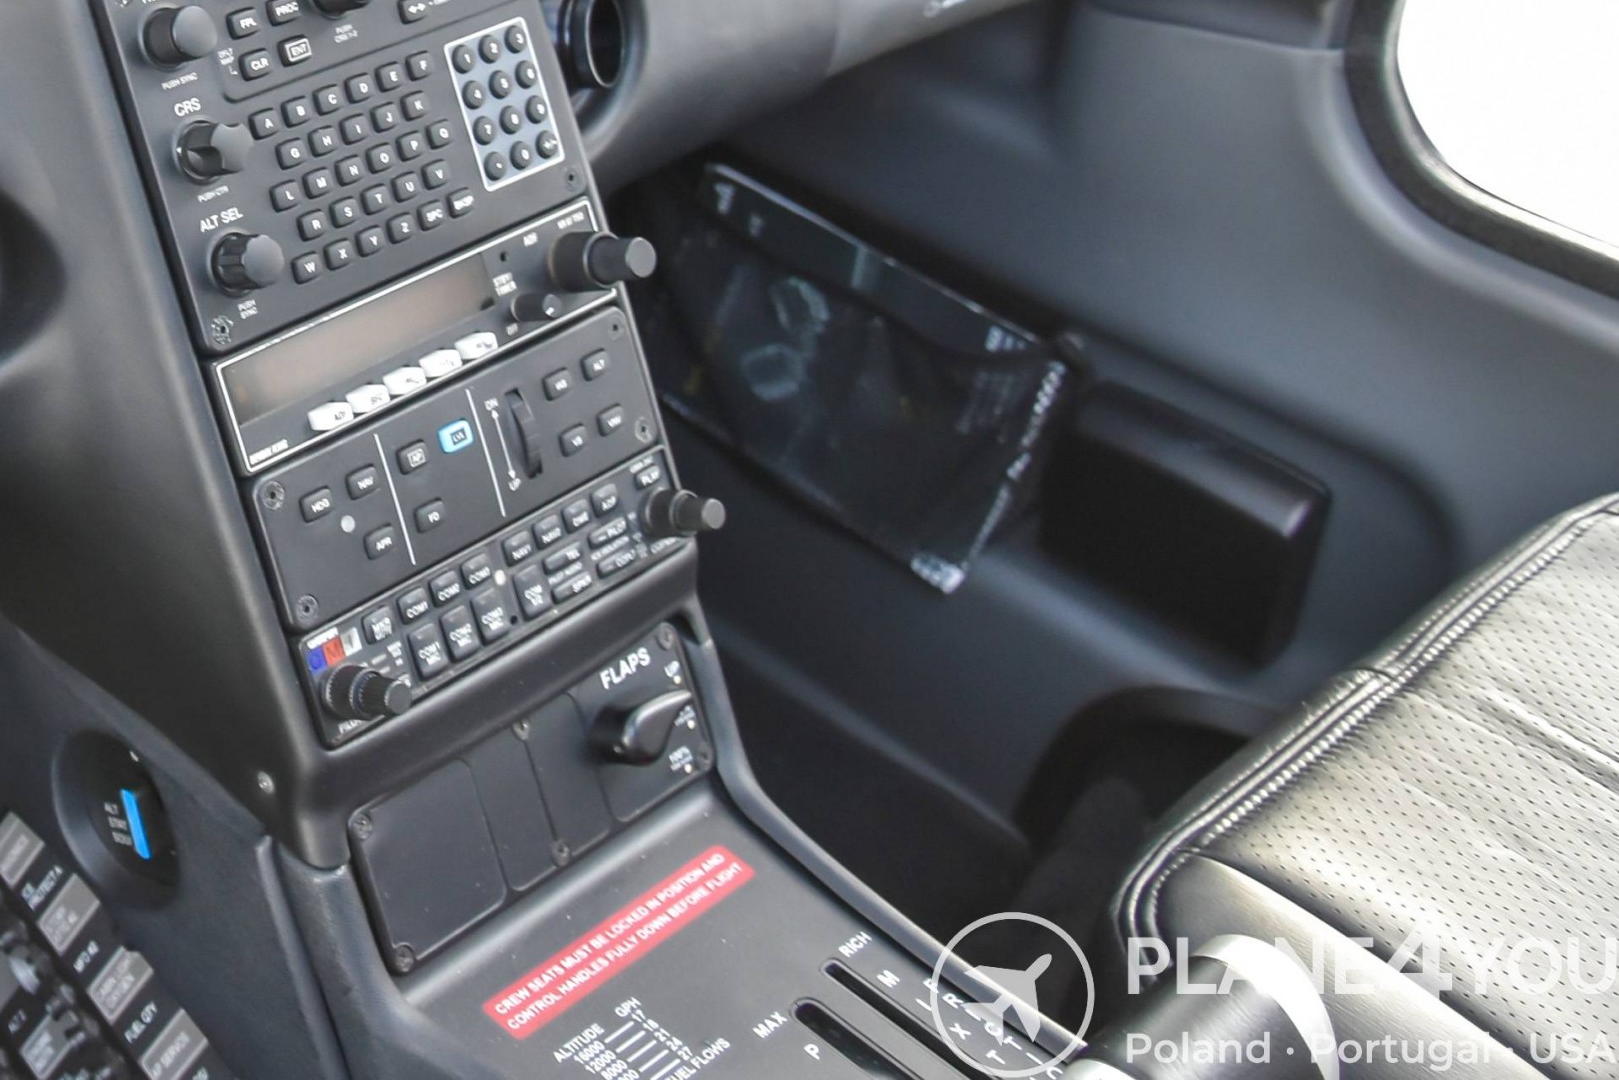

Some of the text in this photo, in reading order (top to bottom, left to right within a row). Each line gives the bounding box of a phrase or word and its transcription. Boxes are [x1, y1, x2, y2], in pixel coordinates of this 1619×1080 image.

[275, 1, 300, 16] PROC
[240, 16, 258, 29] FPL
[292, 44, 308, 56] ENT
[250, 57, 270, 70] CLR
[174, 98, 202, 117] CRS
[410, 140, 419, 152] P
[348, 164, 359, 176] N
[434, 168, 444, 180] V
[404, 181, 415, 192] U
[200, 206, 244, 233] ALT SEL
[344, 206, 352, 218] S
[312, 219, 322, 231] R
[370, 235, 378, 246] Y
[338, 248, 348, 260] X
[304, 262, 316, 274] W
[357, 476, 374, 490] NAV
[310, 498, 330, 514] HDG
[376, 536, 392, 552] APR
[512, 544, 532, 560] NAV1
[524, 584, 543, 600] COM
[406, 601, 429, 618] COM1
[600, 647, 651, 690] FLAPS
[494, 853, 725, 1016] CREW SEATS MUST BE LOCKED IN POSITION AND
[506, 862, 744, 1030] CONTROL HANDLES FULLY DOWN BEFORE FLIGHT
[838, 930, 872, 958] RICH
[614, 996, 642, 1018] GPH
[631, 1009, 646, 1022] 17
[752, 1011, 788, 1039] MAX
[654, 1027, 671, 1042] 21
[552, 1022, 605, 1064] ALTITUDE
[666, 1036, 684, 1052] 24
[573, 1040, 606, 1065] 16000
[677, 1046, 694, 1061] 27
[690, 1037, 731, 1070] FLOWS
[584, 1049, 617, 1075] 12000
